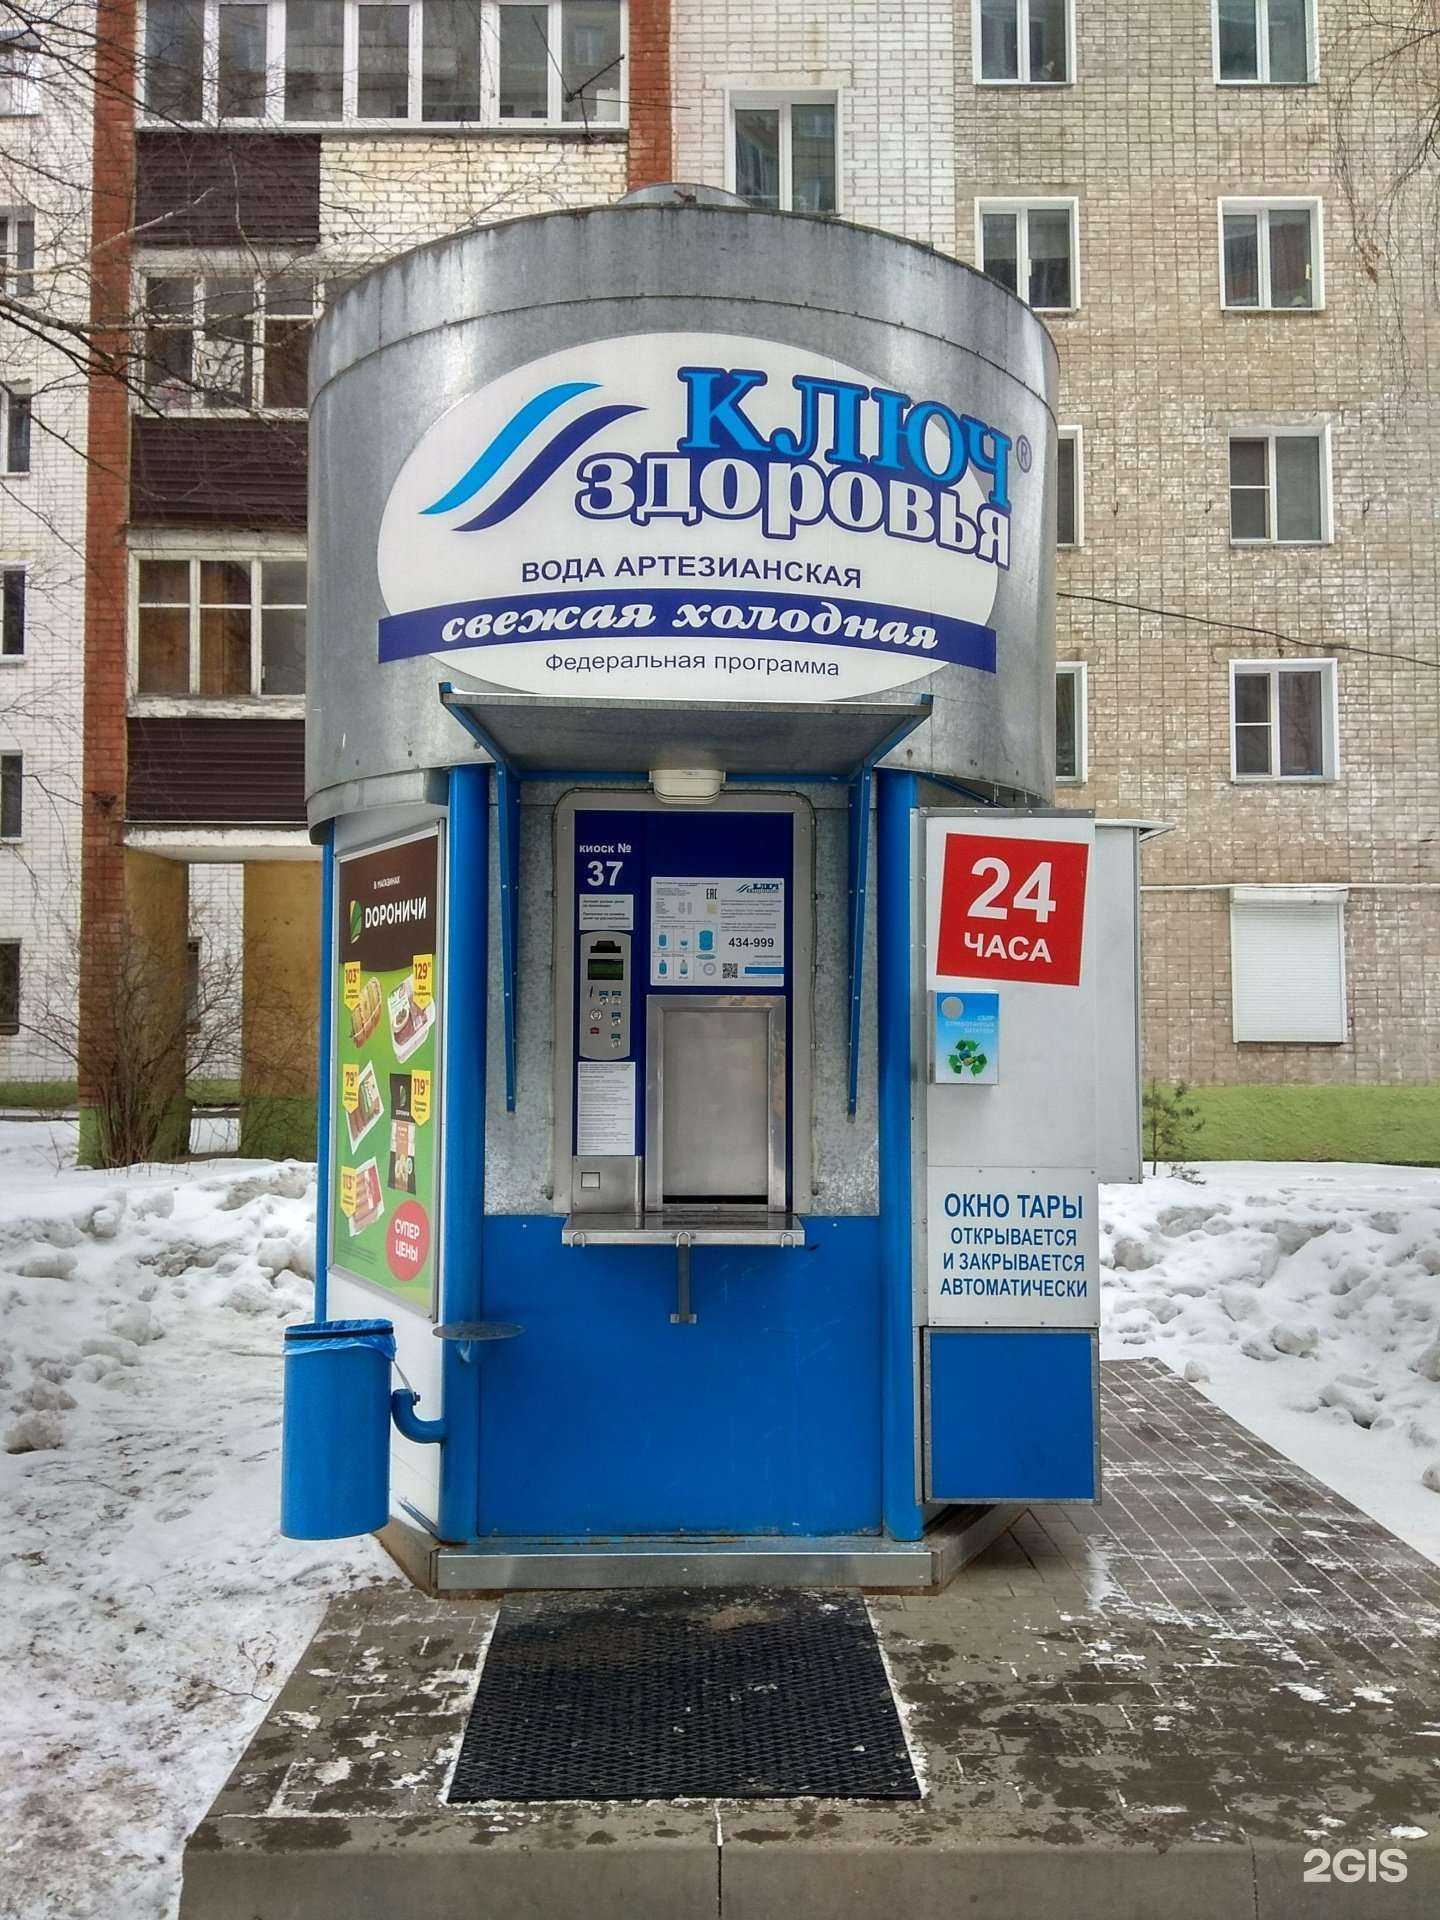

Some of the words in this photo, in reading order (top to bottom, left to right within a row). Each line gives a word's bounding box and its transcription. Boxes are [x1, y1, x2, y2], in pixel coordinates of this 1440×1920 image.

[677, 366, 1013, 510] КЛЮЧ
[521, 557, 605, 584] ВОДА
[614, 555, 862, 589] АРТЕЗИАНСКАЯ
[441, 601, 657, 643] свежая
[672, 600, 939, 650] холодная
[545, 652, 706, 675] Федеральная
[714, 656, 840, 678] программа
[586, 860, 624, 887] 37
[967, 856, 1057, 923] 24
[728, 937, 775, 948] 434-999
[963, 931, 1053, 964] ЧАСА
[944, 1192, 1010, 1218] ОКНО
[1016, 1194, 1083, 1219] ТАРЫ
[394, 1217, 420, 1241] СУПЕР
[950, 1227, 1077, 1246] ОТКРЫВАЕТСЯ
[394, 1240, 419, 1263] ЦЕНЫ
[943, 1252, 954, 1270] И
[959, 1252, 1085, 1272] ЗАКРЫВАЕТСЯ
[940, 1278, 1088, 1298] АВТОМАТИЧЕСКИ
